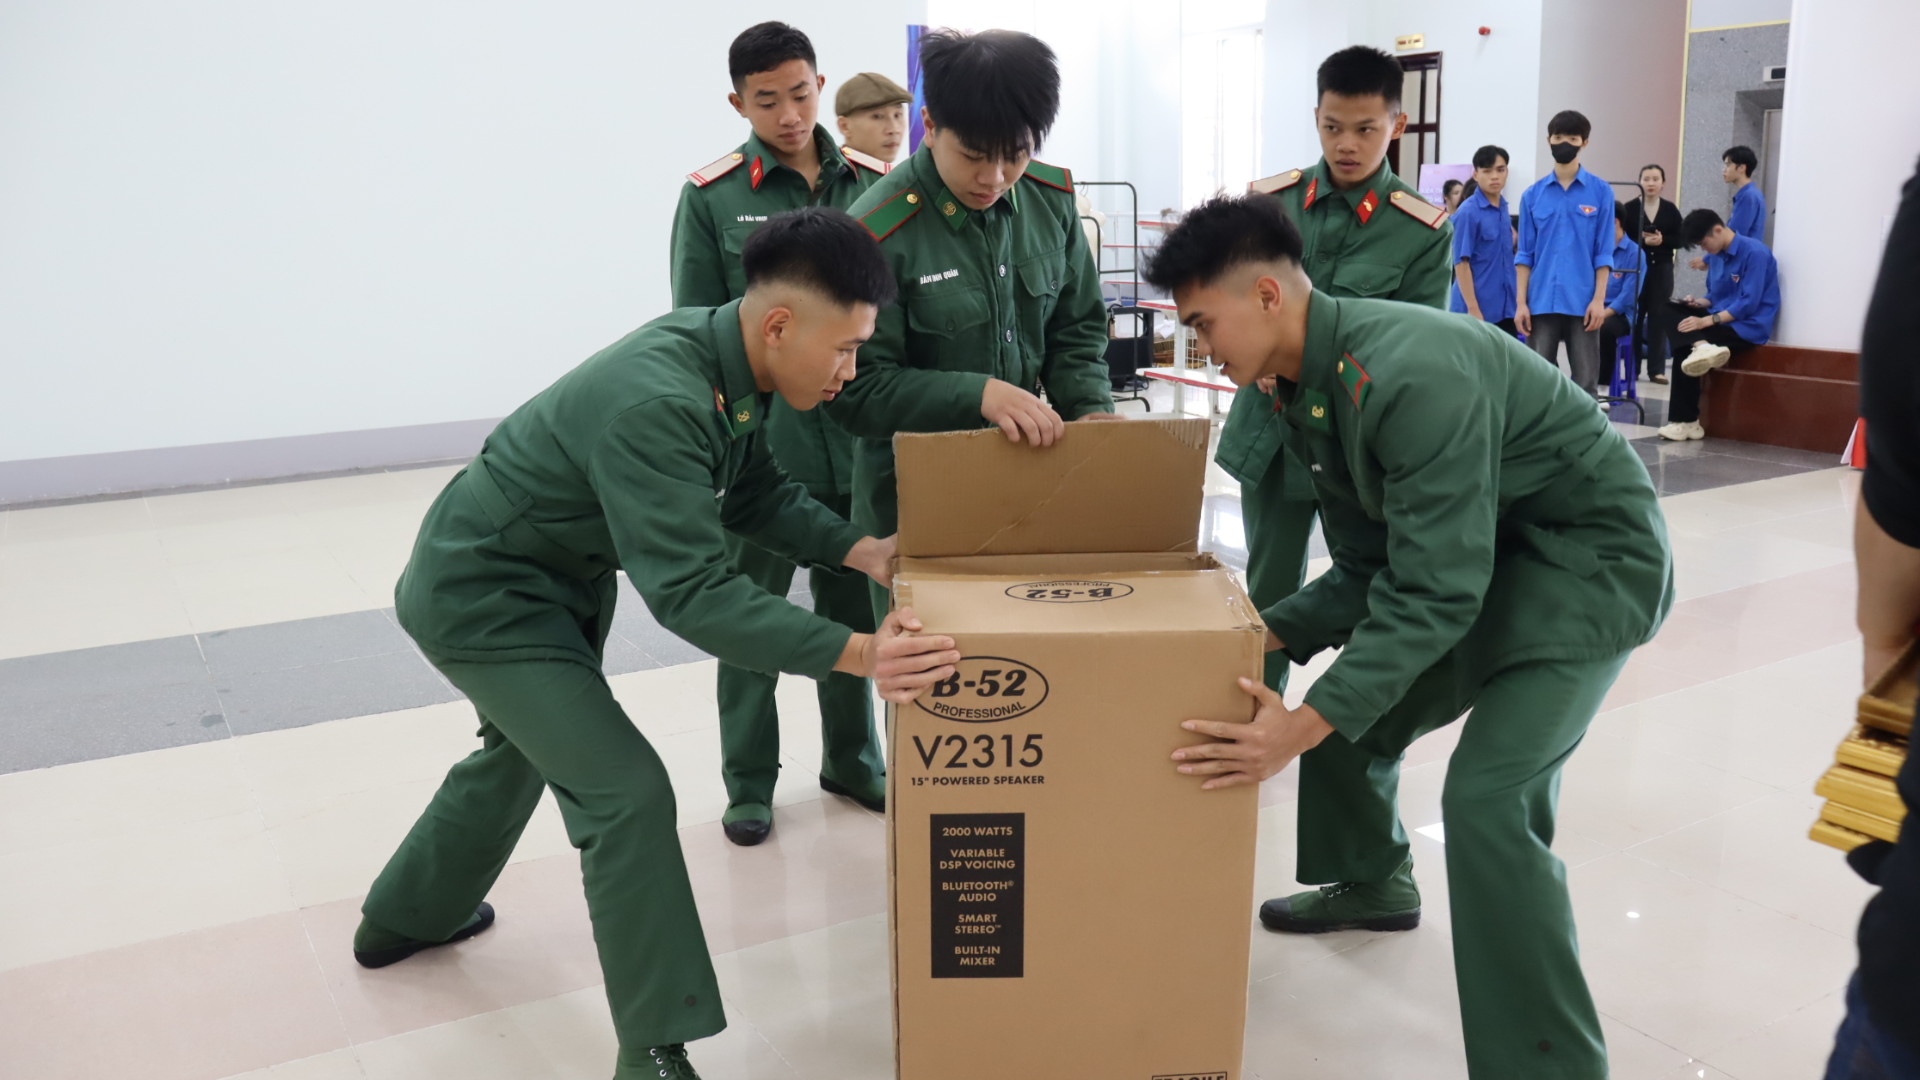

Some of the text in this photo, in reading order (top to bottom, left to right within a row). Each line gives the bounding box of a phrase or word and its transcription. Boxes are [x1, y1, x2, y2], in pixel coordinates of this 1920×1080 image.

[1026, 587, 1113, 599] B-52
[931, 669, 1027, 698] B-52
[933, 701, 1026, 719] PROFESSIONAL
[912, 733, 1044, 771] V2315
[911, 775, 1045, 786] 15" POWERED SPEAKER
[942, 826, 1013, 837] 2000 WATTS
[950, 849, 1005, 858] VARIABLE
[939, 860, 1016, 870] DSP VOICING
[958, 893, 997, 902] AUDIO
[958, 914, 998, 923] SMART
[954, 946, 1000, 955] BUILT-IN
[959, 957, 996, 966] MIXER
